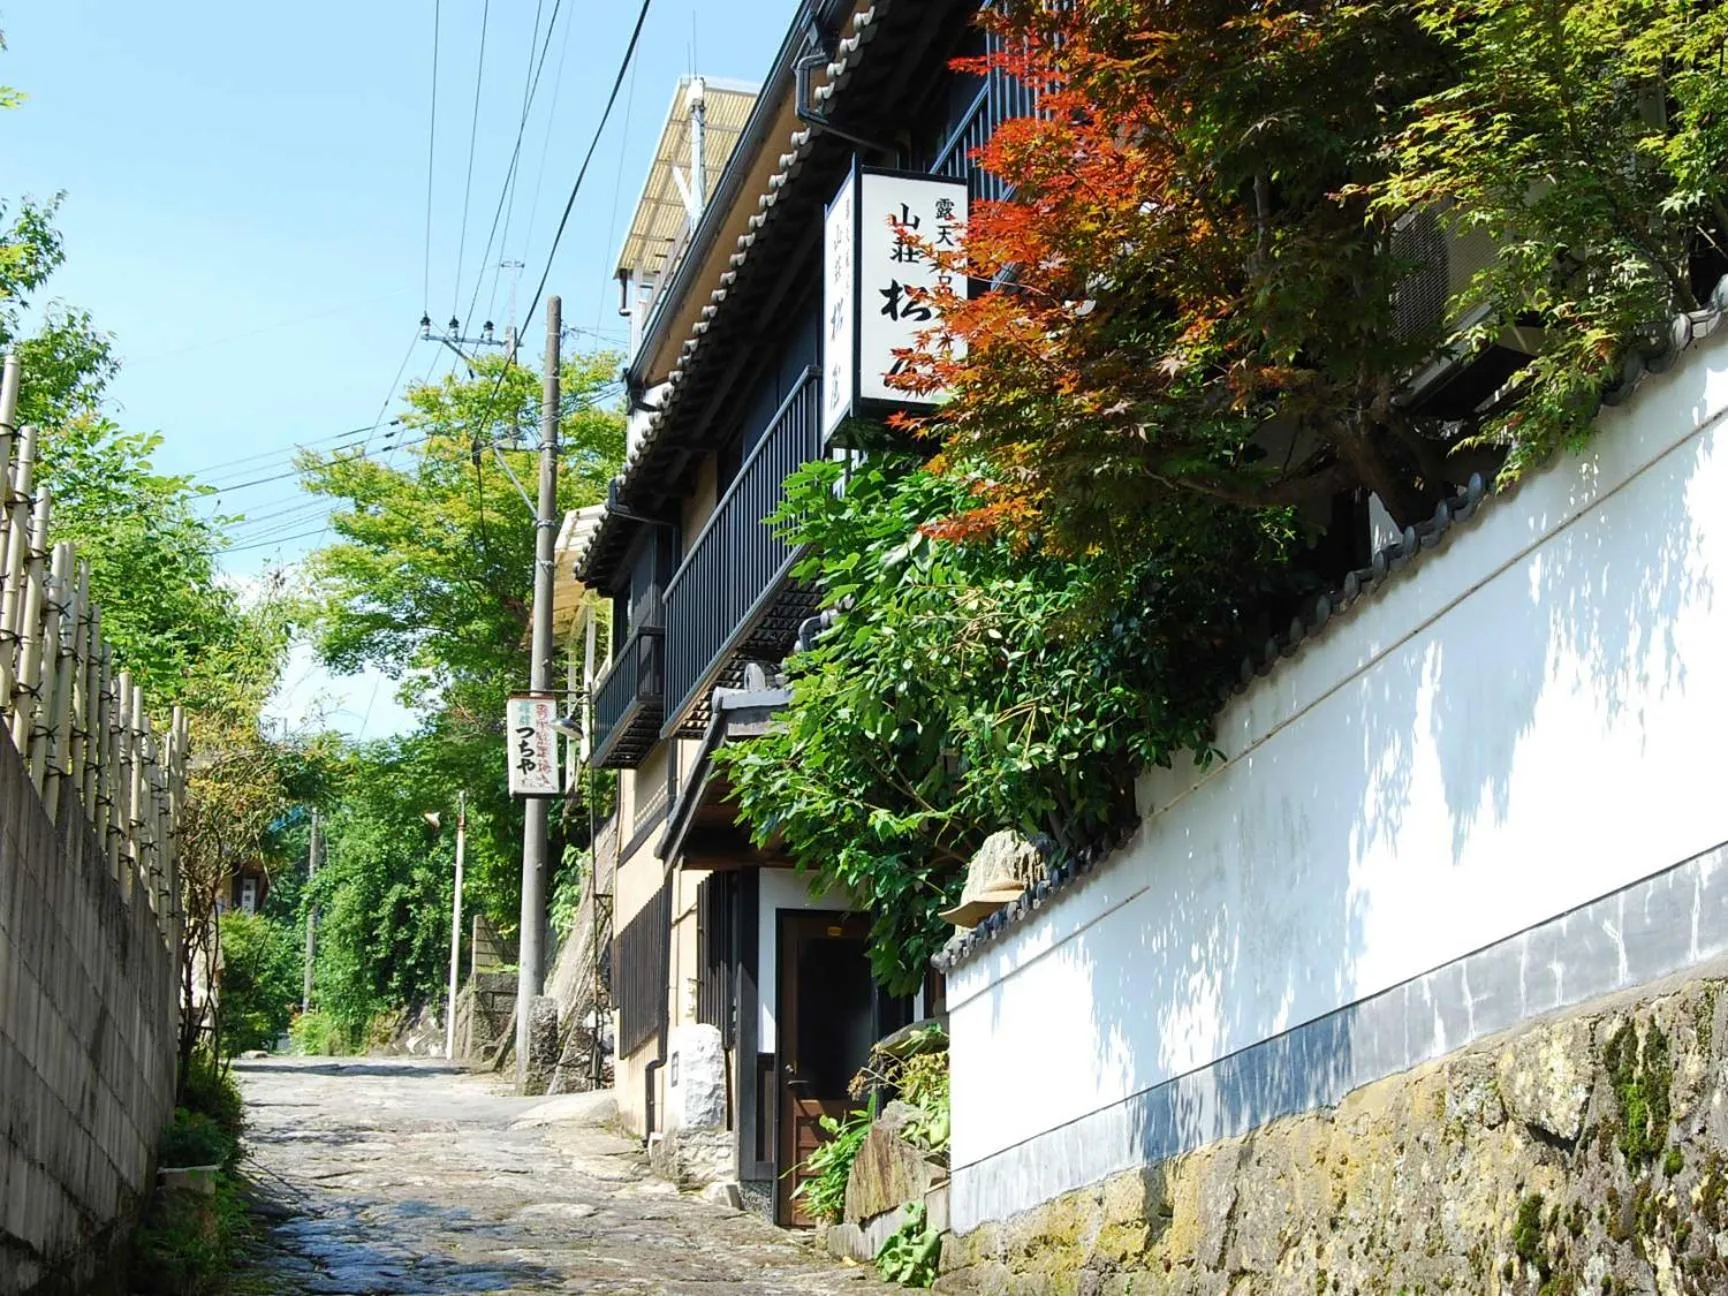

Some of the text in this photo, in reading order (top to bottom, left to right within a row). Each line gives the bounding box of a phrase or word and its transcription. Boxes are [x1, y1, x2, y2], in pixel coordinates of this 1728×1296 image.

[935, 197, 956, 299] 露天呂
[516, 726, 537, 775] つちや
